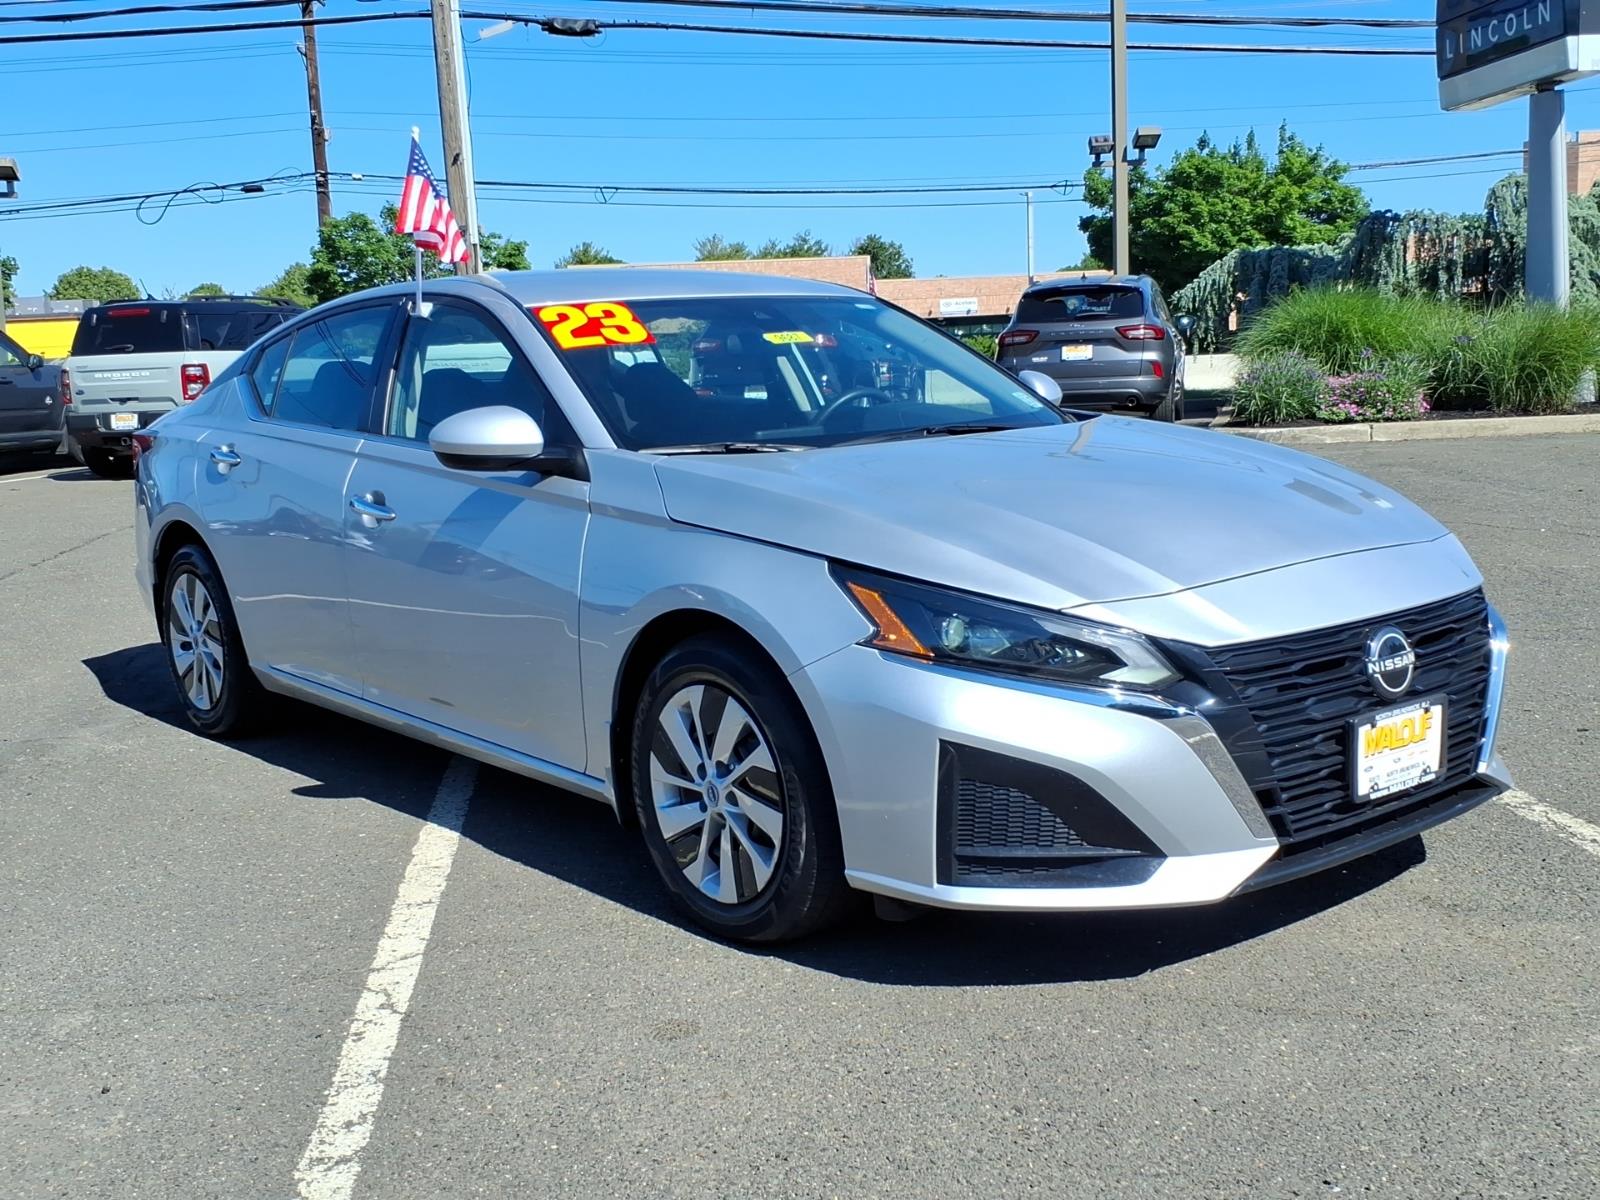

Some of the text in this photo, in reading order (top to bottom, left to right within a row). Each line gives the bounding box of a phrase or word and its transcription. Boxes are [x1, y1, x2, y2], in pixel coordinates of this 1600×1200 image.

[1445, 0, 1551, 59] LINCOLN
[538, 302, 648, 349] 23
[1368, 651, 1416, 674] NISSAN
[1363, 710, 1434, 758] MALOUF
